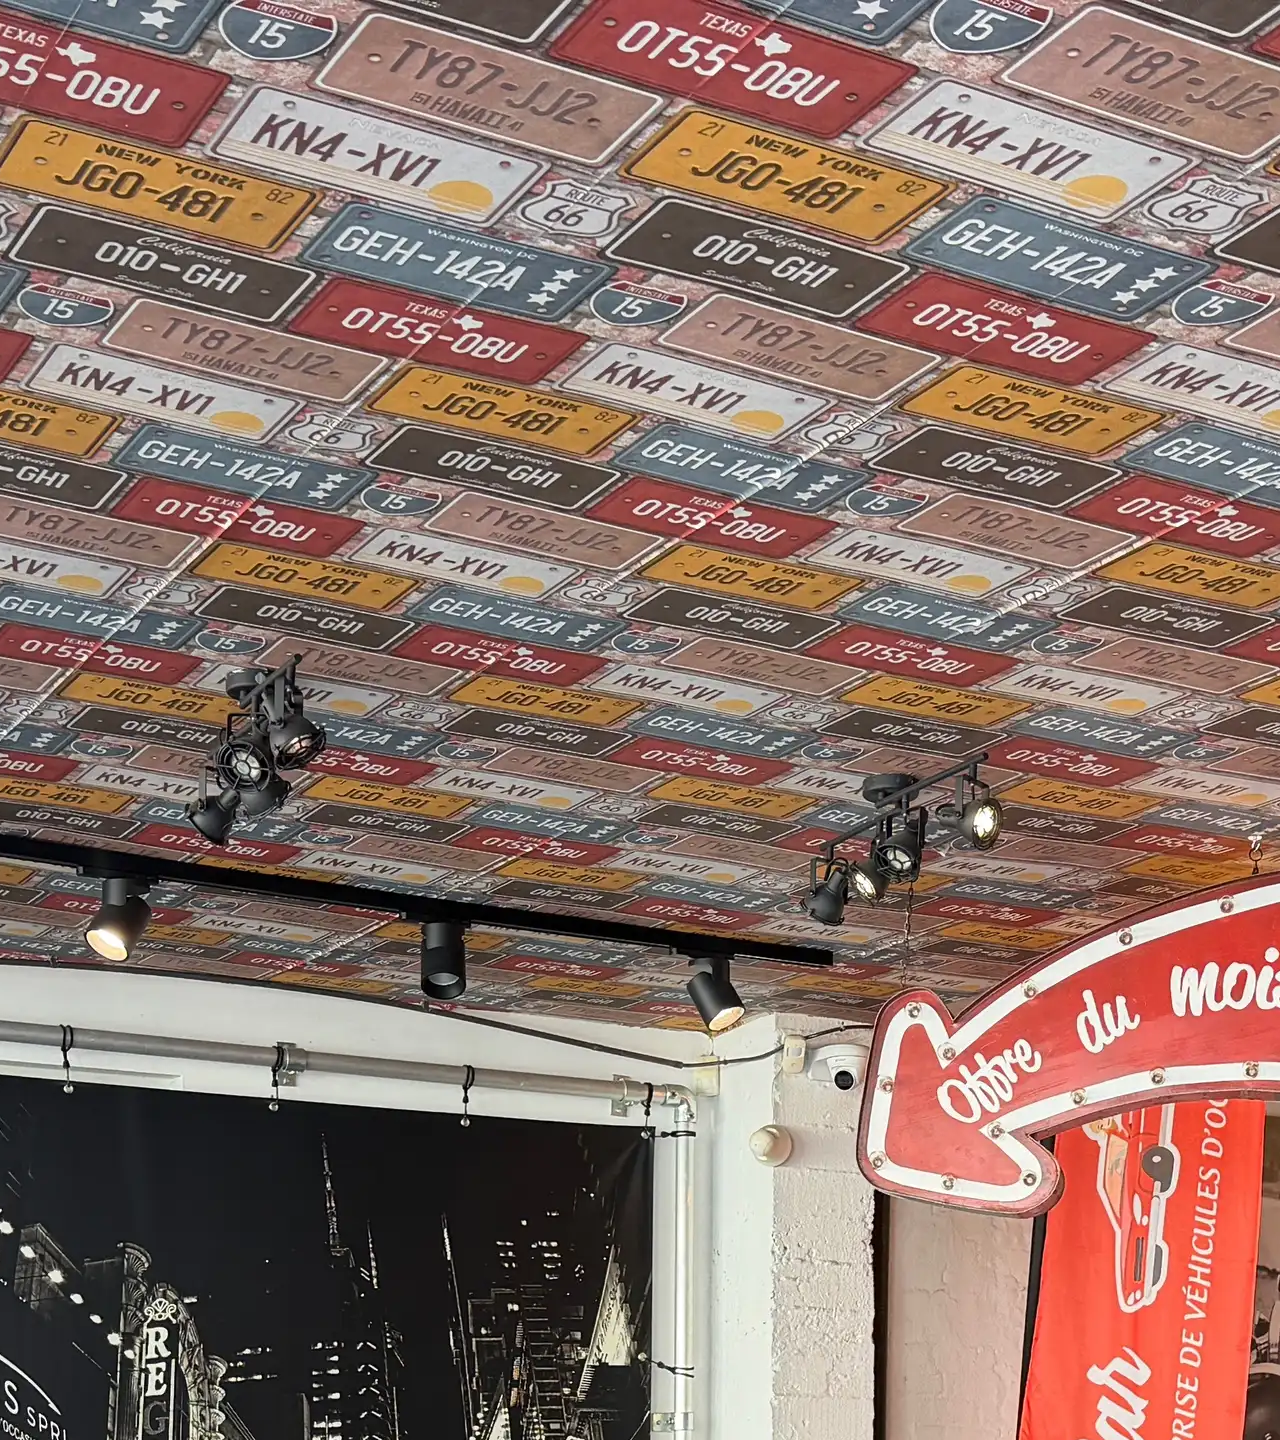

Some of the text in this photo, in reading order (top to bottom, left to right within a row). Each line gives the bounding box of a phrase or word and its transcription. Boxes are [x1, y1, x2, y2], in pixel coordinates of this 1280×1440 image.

[248, 19, 293, 48] 15
[699, 12, 751, 37] TEXAS
[954, 9, 1006, 40] 15
[389, 39, 597, 124] TY87-JJ2
[1082, 34, 1279, 120] TY87-JJ2
[95, 143, 246, 190] NEW YORK
[250, 113, 440, 186] KN4-XV1
[745, 135, 884, 181] NEW YORK
[907, 107, 1091, 180] KN4-XV1
[543, 204, 588, 226] 66
[1168, 200, 1217, 222] 66
[333, 225, 525, 290] GEH-142A
[942, 220, 1126, 286] GEH-142A
[611, 297, 651, 317] 15
[1191, 296, 1236, 316] 15
[161, 318, 334, 375] TY87-JJ2
[720, 315, 886, 372] TY87-JJ2
[56, 363, 215, 413] KN4-XV1
[592, 361, 747, 412] KN4-XV1
[137, 441, 301, 487] GEH-142A
[937, 1039, 1041, 1123] Offre
[1076, 990, 1140, 1053] du
[1182, 1167, 1220, 1320] VÉHICULES
[1180, 1328, 1204, 1368] DE
